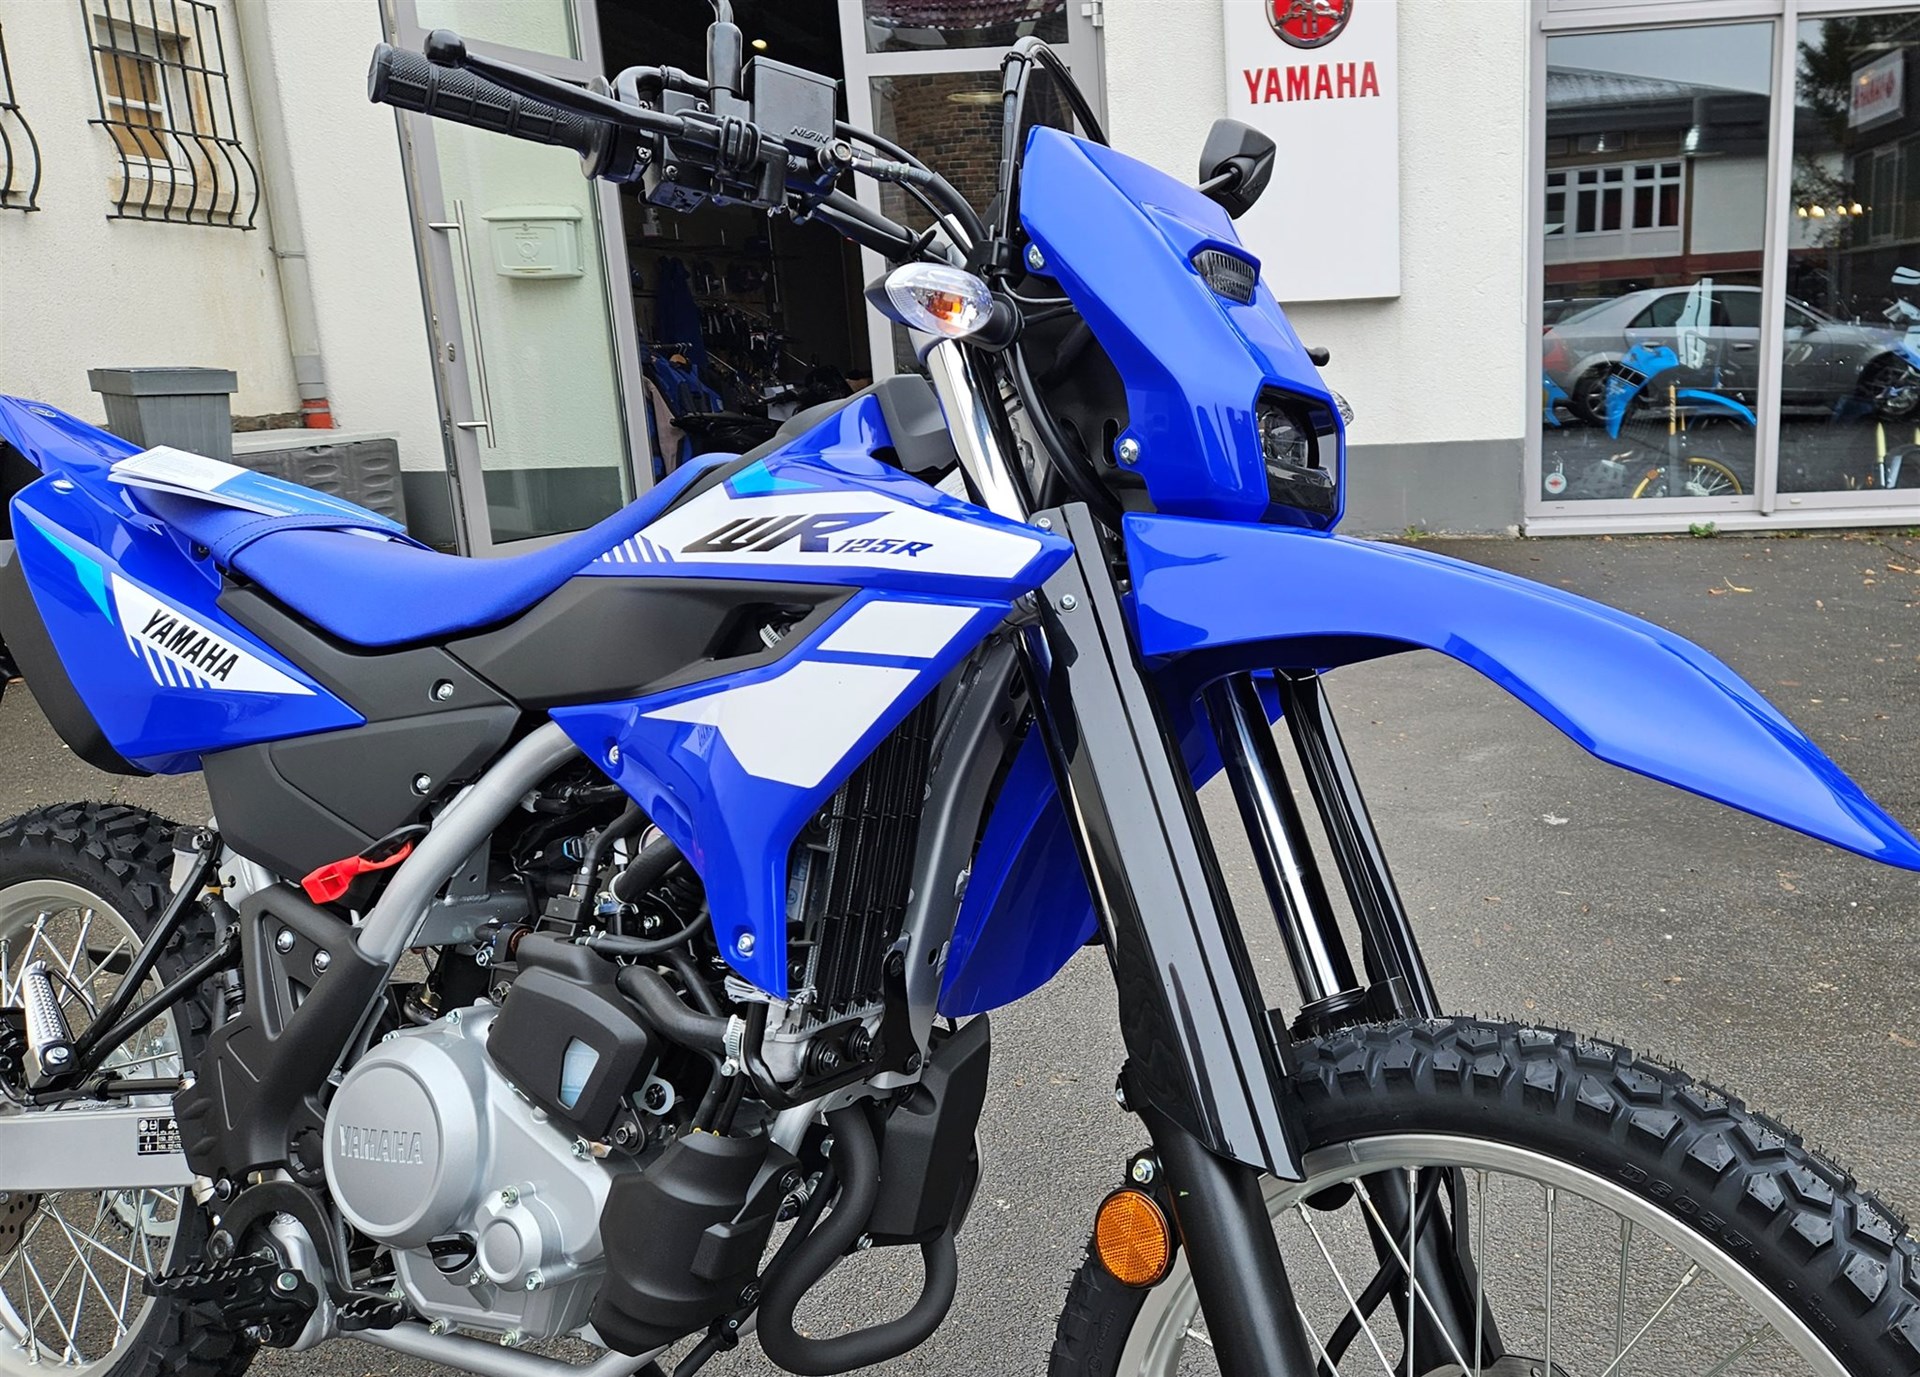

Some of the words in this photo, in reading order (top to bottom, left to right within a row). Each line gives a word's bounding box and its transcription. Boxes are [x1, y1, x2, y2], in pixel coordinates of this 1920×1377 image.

[1243, 61, 1380, 104] YAMAHA
[681, 511, 895, 553] WR
[832, 538, 934, 557] 125R
[141, 608, 239, 682] YAMAHA
[340, 1125, 423, 1164] YAMAHA
